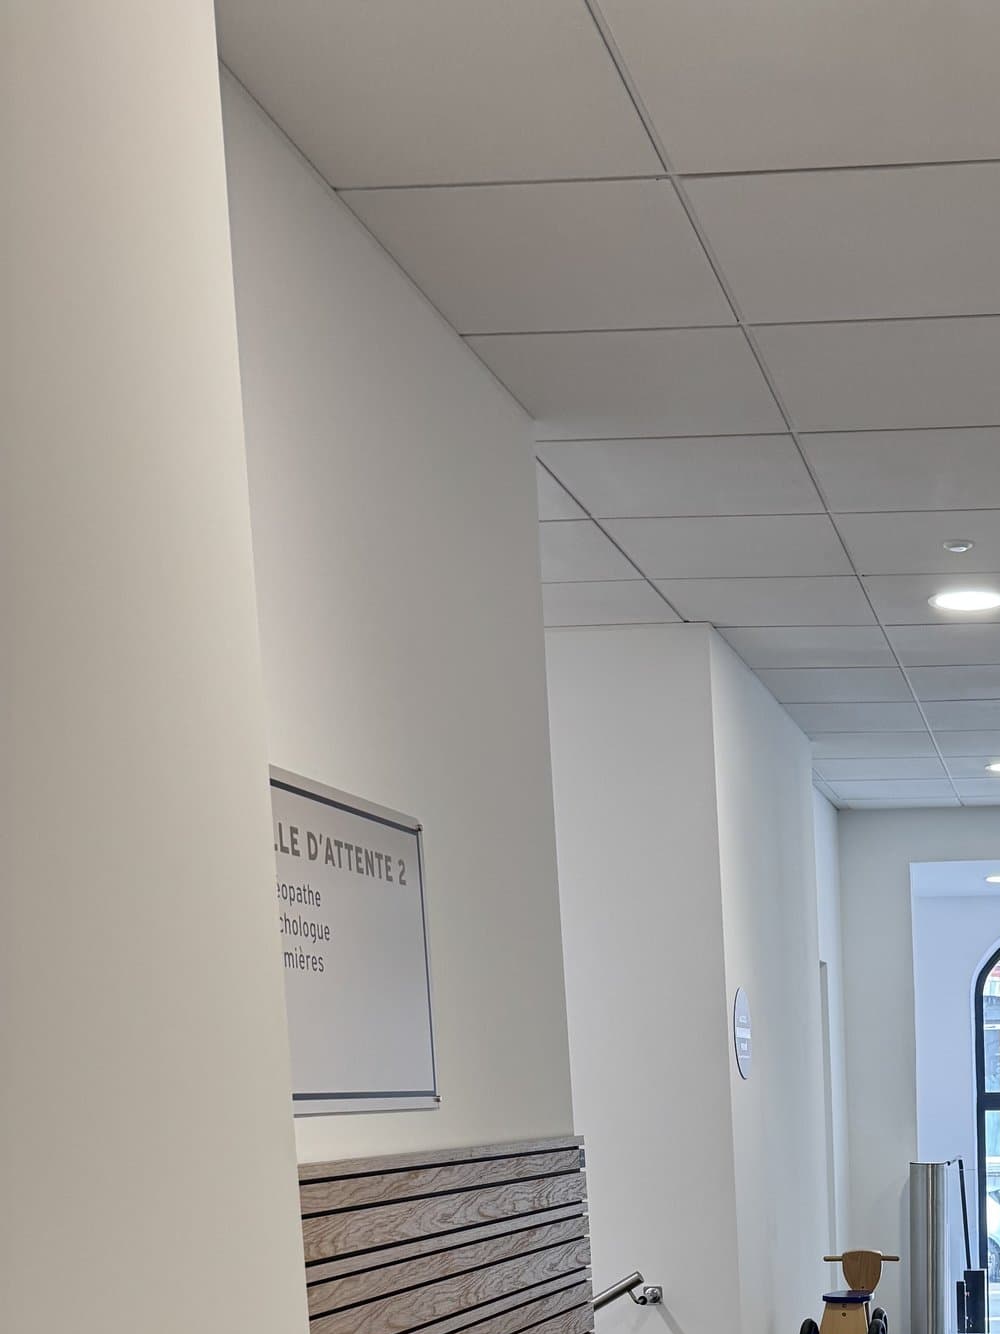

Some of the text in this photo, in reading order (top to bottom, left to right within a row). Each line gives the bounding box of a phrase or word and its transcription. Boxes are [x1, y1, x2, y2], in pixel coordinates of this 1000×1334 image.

[274, 822, 407, 886] LE D'ATTENTE 2
